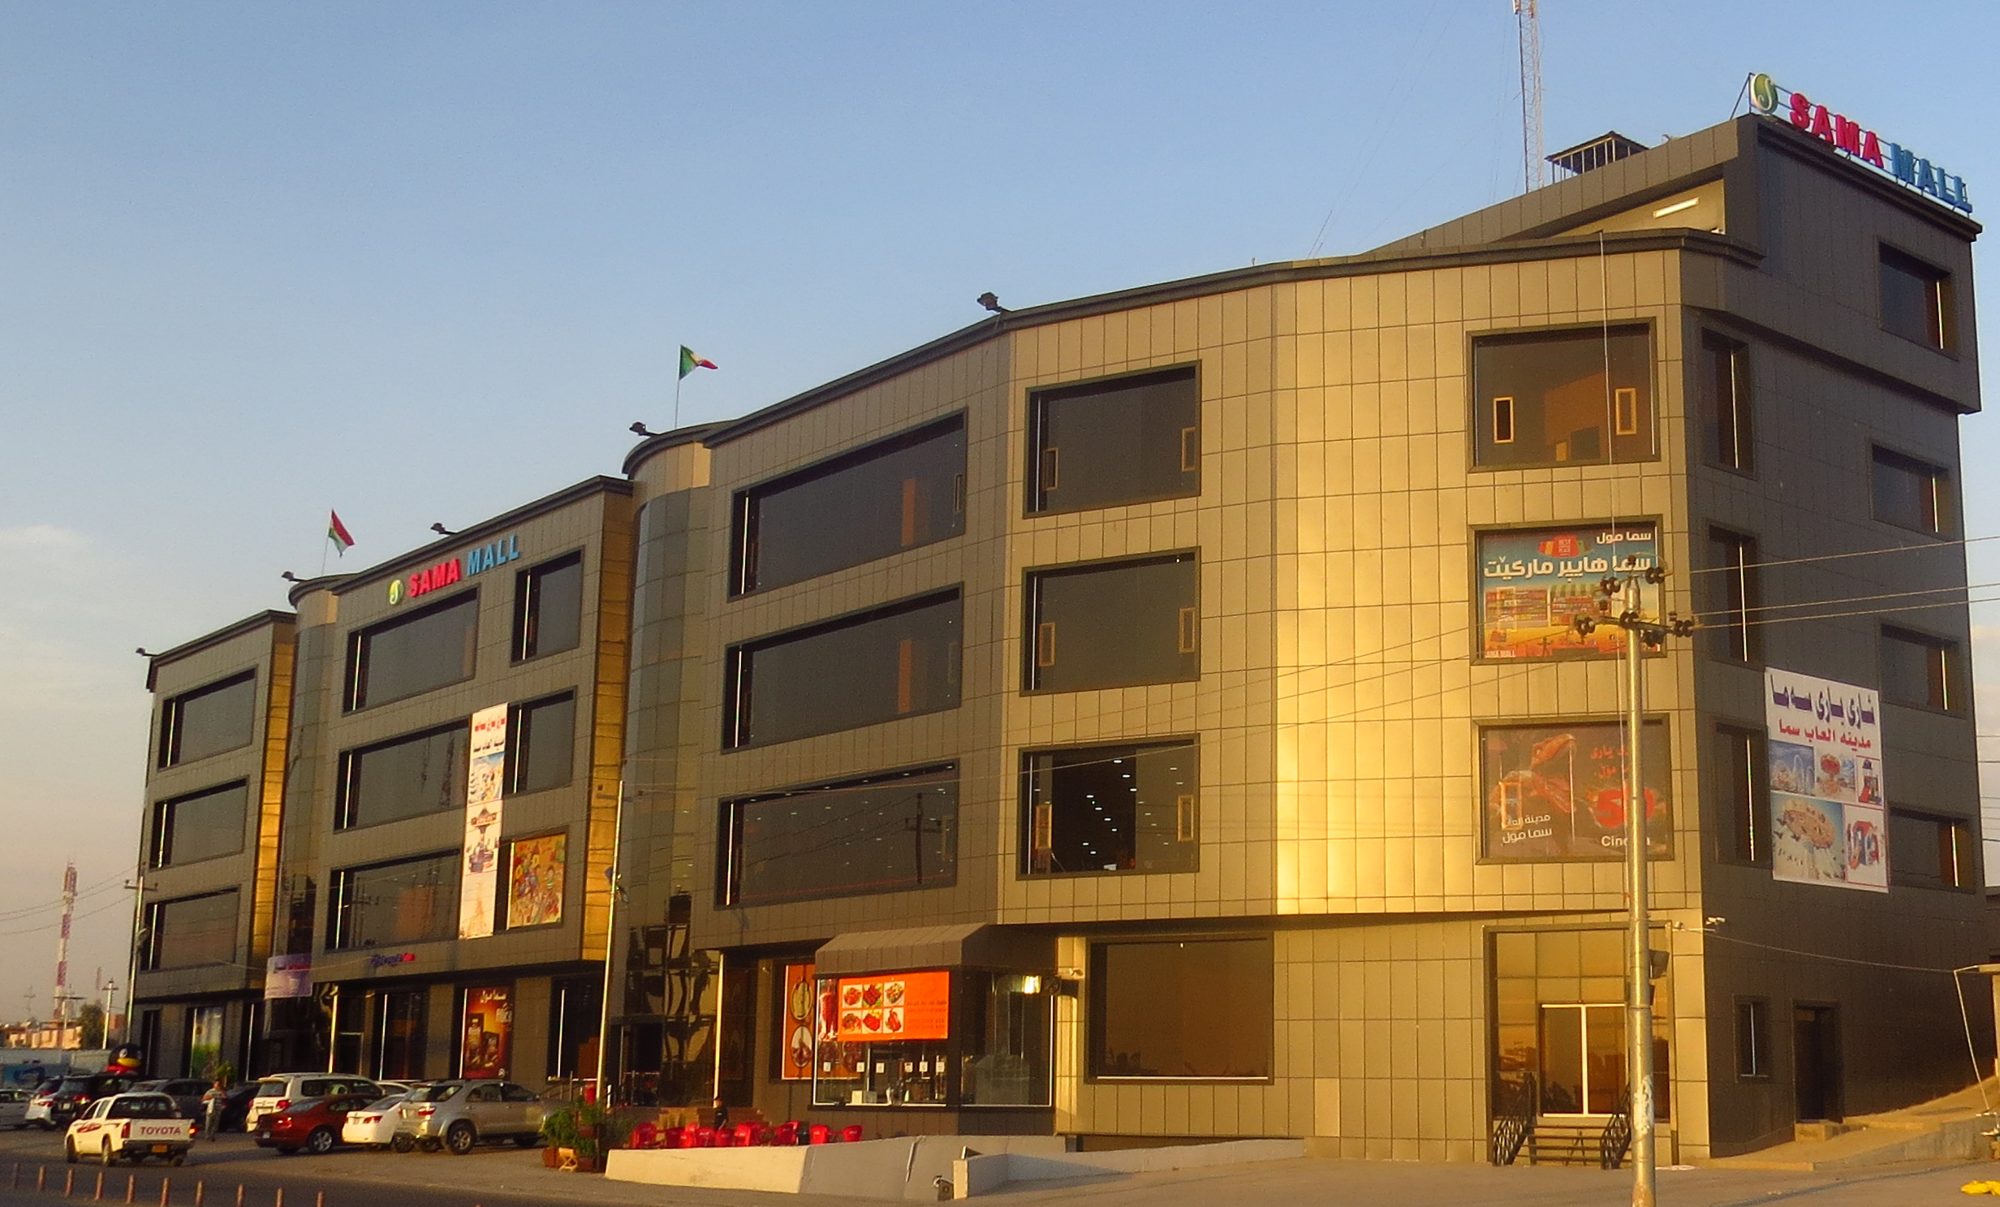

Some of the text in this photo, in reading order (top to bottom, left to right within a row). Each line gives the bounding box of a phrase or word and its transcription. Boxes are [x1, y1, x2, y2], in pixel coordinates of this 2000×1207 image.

[1789, 92, 1973, 214] SAMA MALL
[1596, 531, 1652, 545] سما مول
[408, 534, 520, 598] SAMA MALL
[1502, 828, 1553, 844] سما مول
[140, 1126, 182, 1135] TOYOTA
